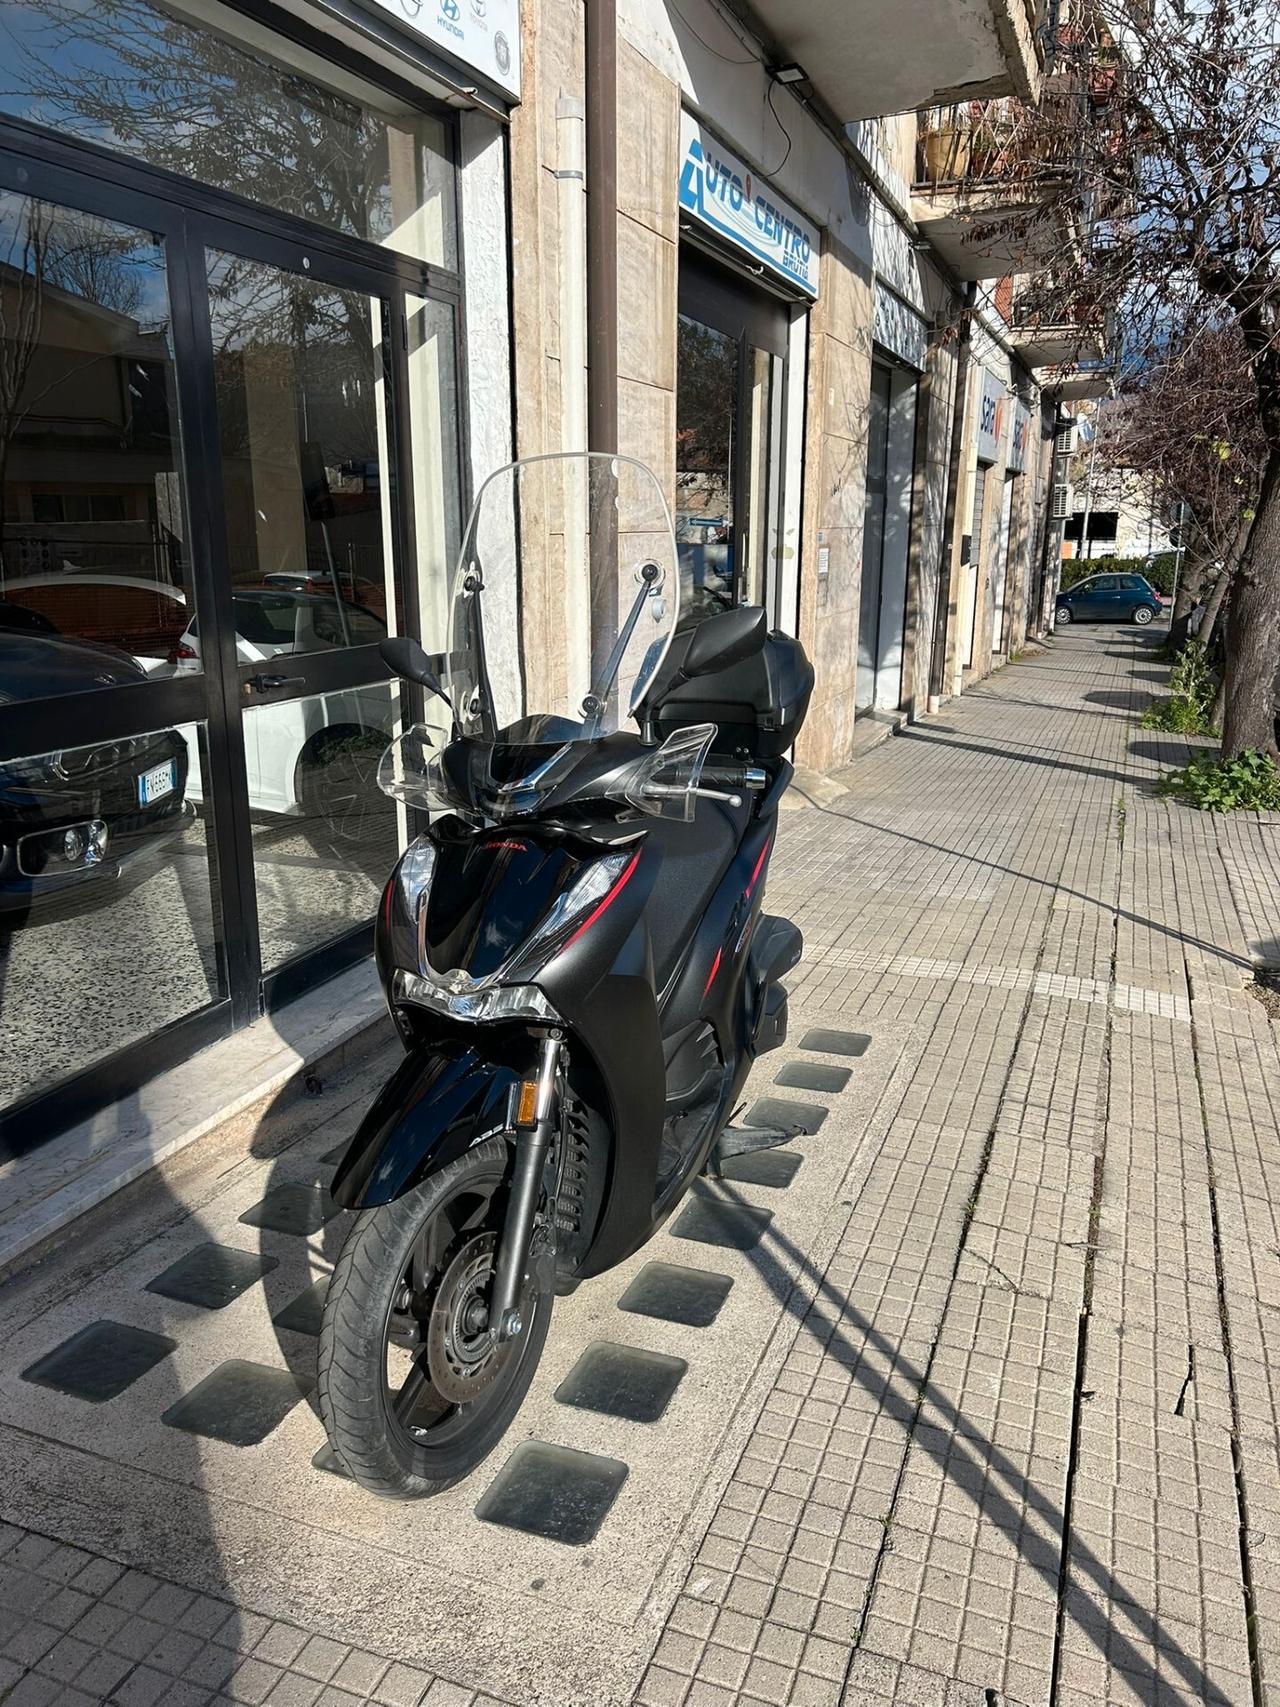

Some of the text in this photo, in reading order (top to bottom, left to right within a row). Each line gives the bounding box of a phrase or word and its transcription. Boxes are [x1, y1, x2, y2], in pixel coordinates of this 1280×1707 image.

[437, 15, 465, 40] HYUNDAI
[679, 138, 811, 264] AUTO CENTRO
[484, 840, 528, 852] HONDA
